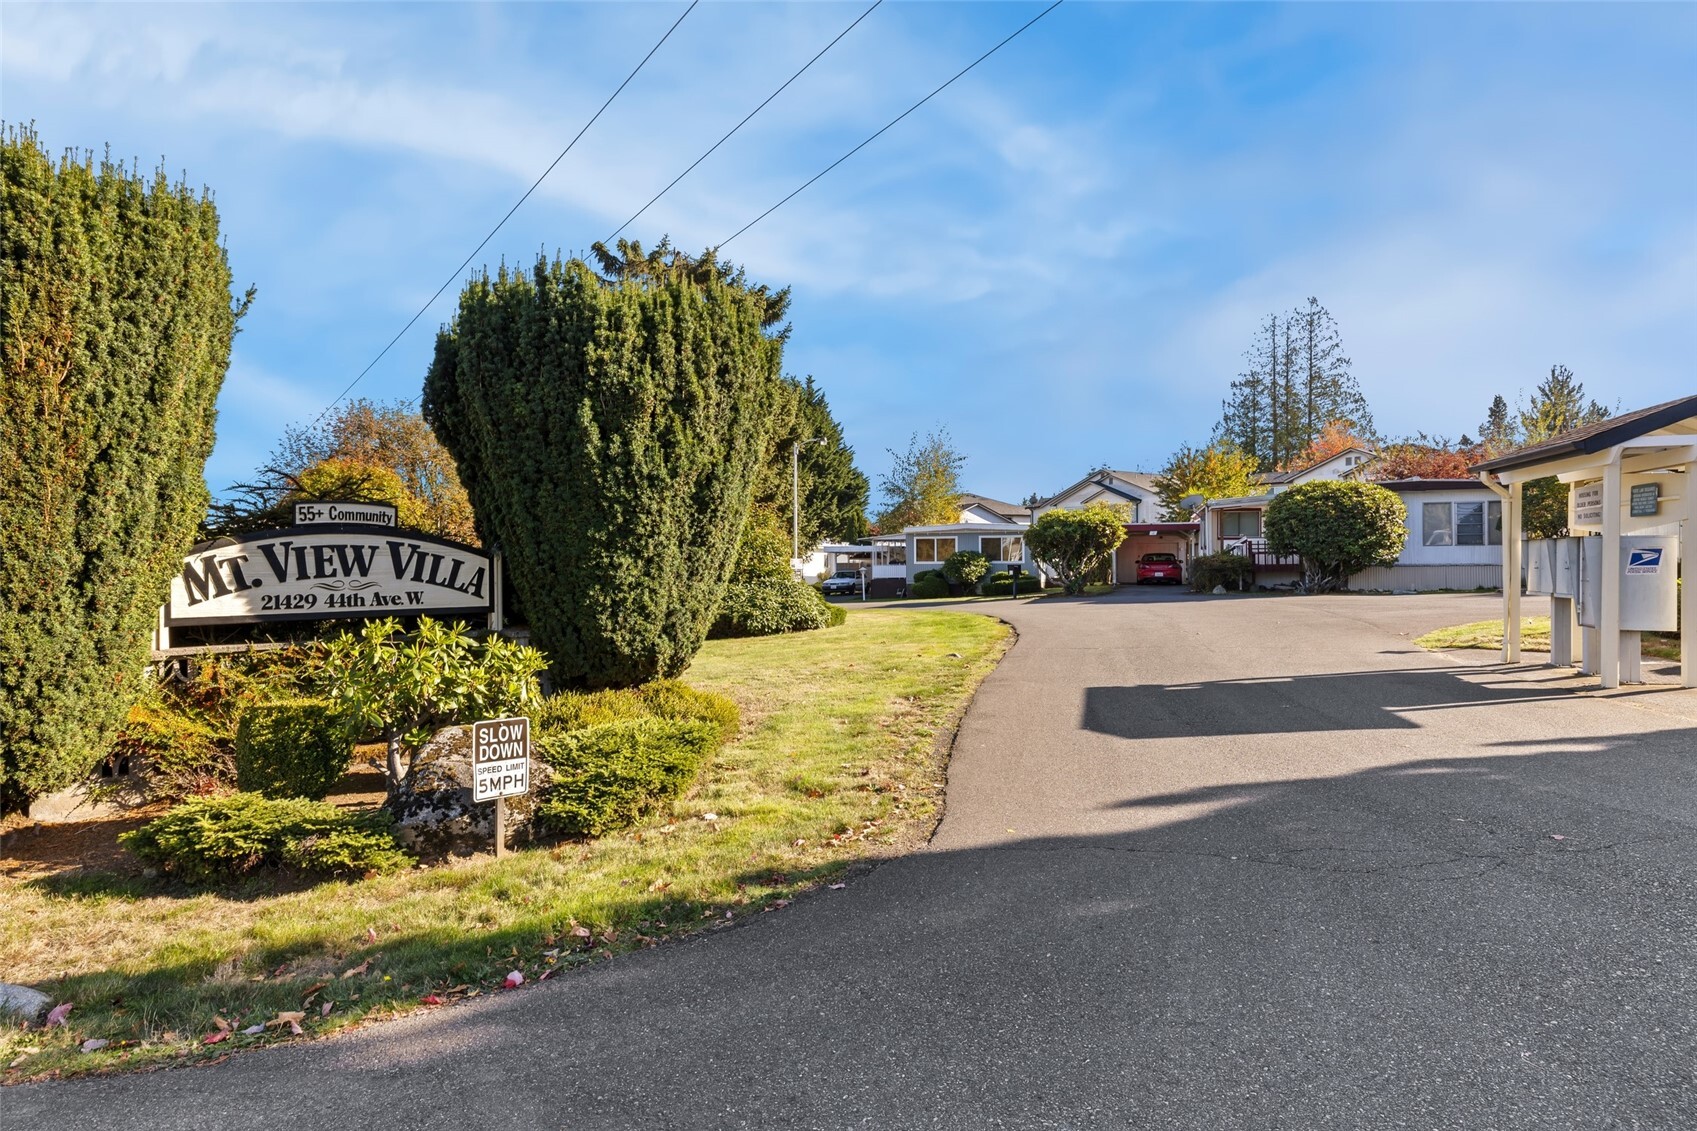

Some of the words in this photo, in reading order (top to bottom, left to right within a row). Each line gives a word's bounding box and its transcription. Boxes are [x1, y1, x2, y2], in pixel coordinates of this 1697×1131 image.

[298, 506, 324, 521] 55+
[329, 506, 393, 525] Community
[257, 541, 379, 583] VIEW
[385, 540, 486, 599] VILLA
[261, 593, 318, 610] 21429
[323, 592, 365, 608] 44th
[369, 591, 404, 607] Ave.
[479, 725, 523, 744] SLOW
[479, 741, 523, 761] DOWN
[478, 765, 502, 775] SPEED
[506, 762, 524, 771] LIMIT
[479, 773, 524, 793] 5MPH
